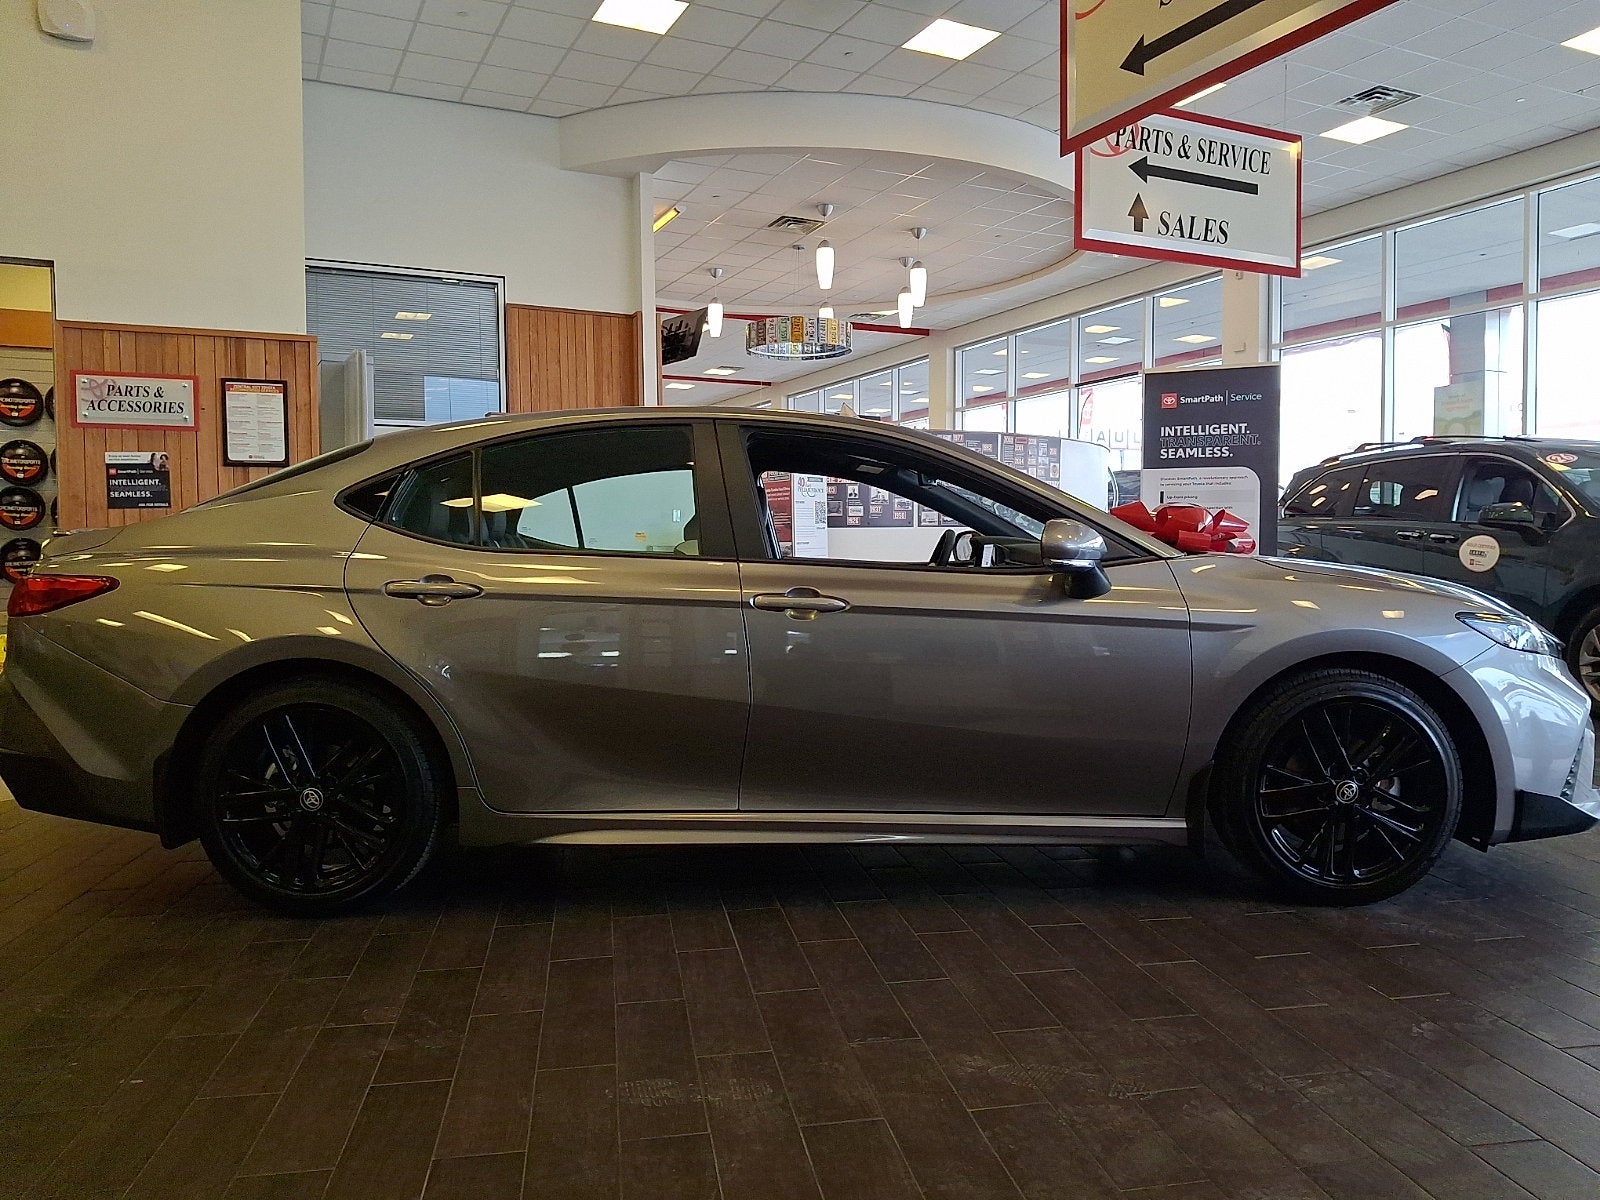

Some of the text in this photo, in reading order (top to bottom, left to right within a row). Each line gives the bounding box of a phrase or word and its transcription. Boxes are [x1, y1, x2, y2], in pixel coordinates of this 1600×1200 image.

[1114, 126, 1272, 175] PARTS & SERVICE
[1157, 210, 1230, 245] SALES
[106, 384, 165, 399] PARTS &
[1179, 391, 1263, 405] SmartPath Service
[86, 399, 185, 414] ACCESSORIES
[1159, 423, 1250, 437] INTELLIGENT.
[1159, 433, 1261, 448] TRANSPARENT.
[1159, 446, 1234, 459] SEAMLESS.
[109, 478, 162, 486] INTELLIGENT.
